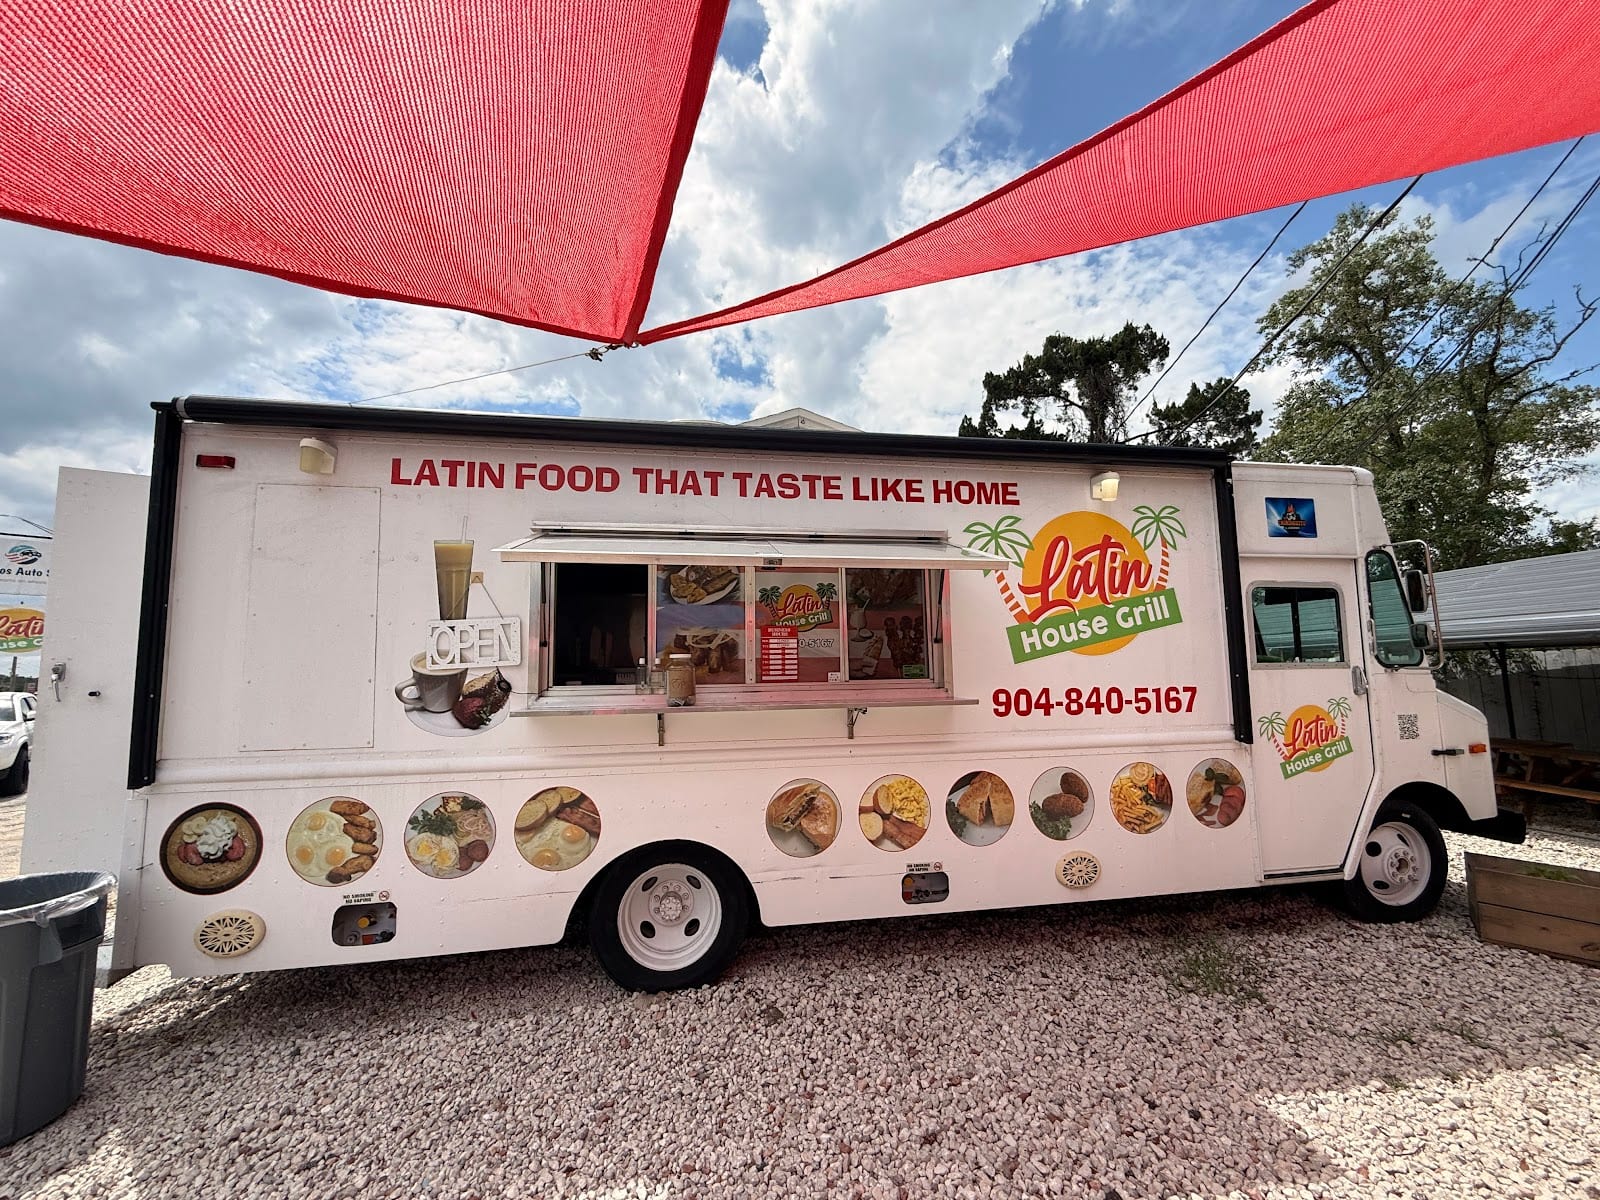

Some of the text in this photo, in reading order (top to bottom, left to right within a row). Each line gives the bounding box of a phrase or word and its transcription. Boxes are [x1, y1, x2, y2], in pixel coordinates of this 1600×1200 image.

[391, 458, 1020, 507] LATIN FOOD THAT TASTE LIKE HOME
[15, 567, 43, 577] Auto
[1017, 534, 1154, 623] Latin
[776, 592, 822, 618] Latin
[808, 611, 828, 623] Grill
[0, 615, 45, 640] ati
[1020, 595, 1170, 654] House Grill
[431, 623, 516, 664] OPEN
[993, 686, 1198, 718] 904-840-5167
[1283, 714, 1339, 760] Latin
[1285, 740, 1348, 775] House Grill
